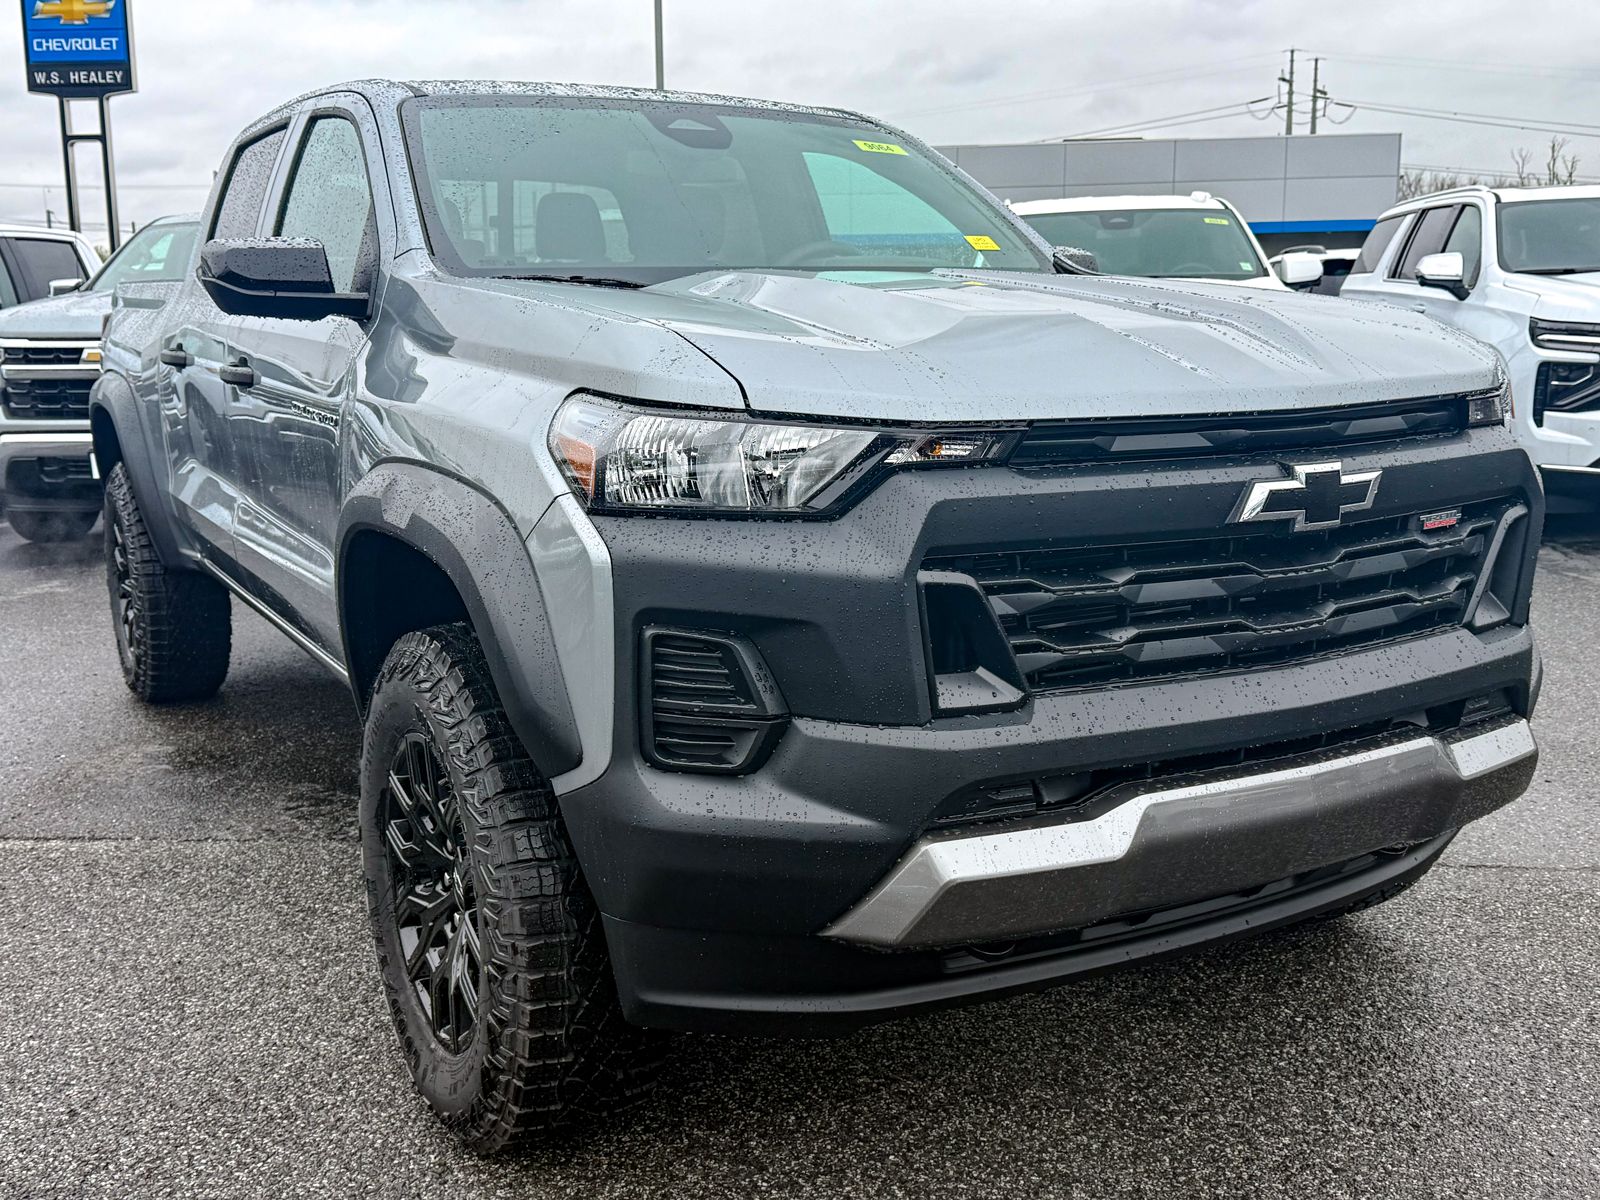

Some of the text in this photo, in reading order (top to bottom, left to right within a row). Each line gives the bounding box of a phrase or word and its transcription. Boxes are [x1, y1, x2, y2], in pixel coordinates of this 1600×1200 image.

[33, 37, 119, 52] CHEVROLET
[34, 70, 123, 84] W.S. HEALEY
